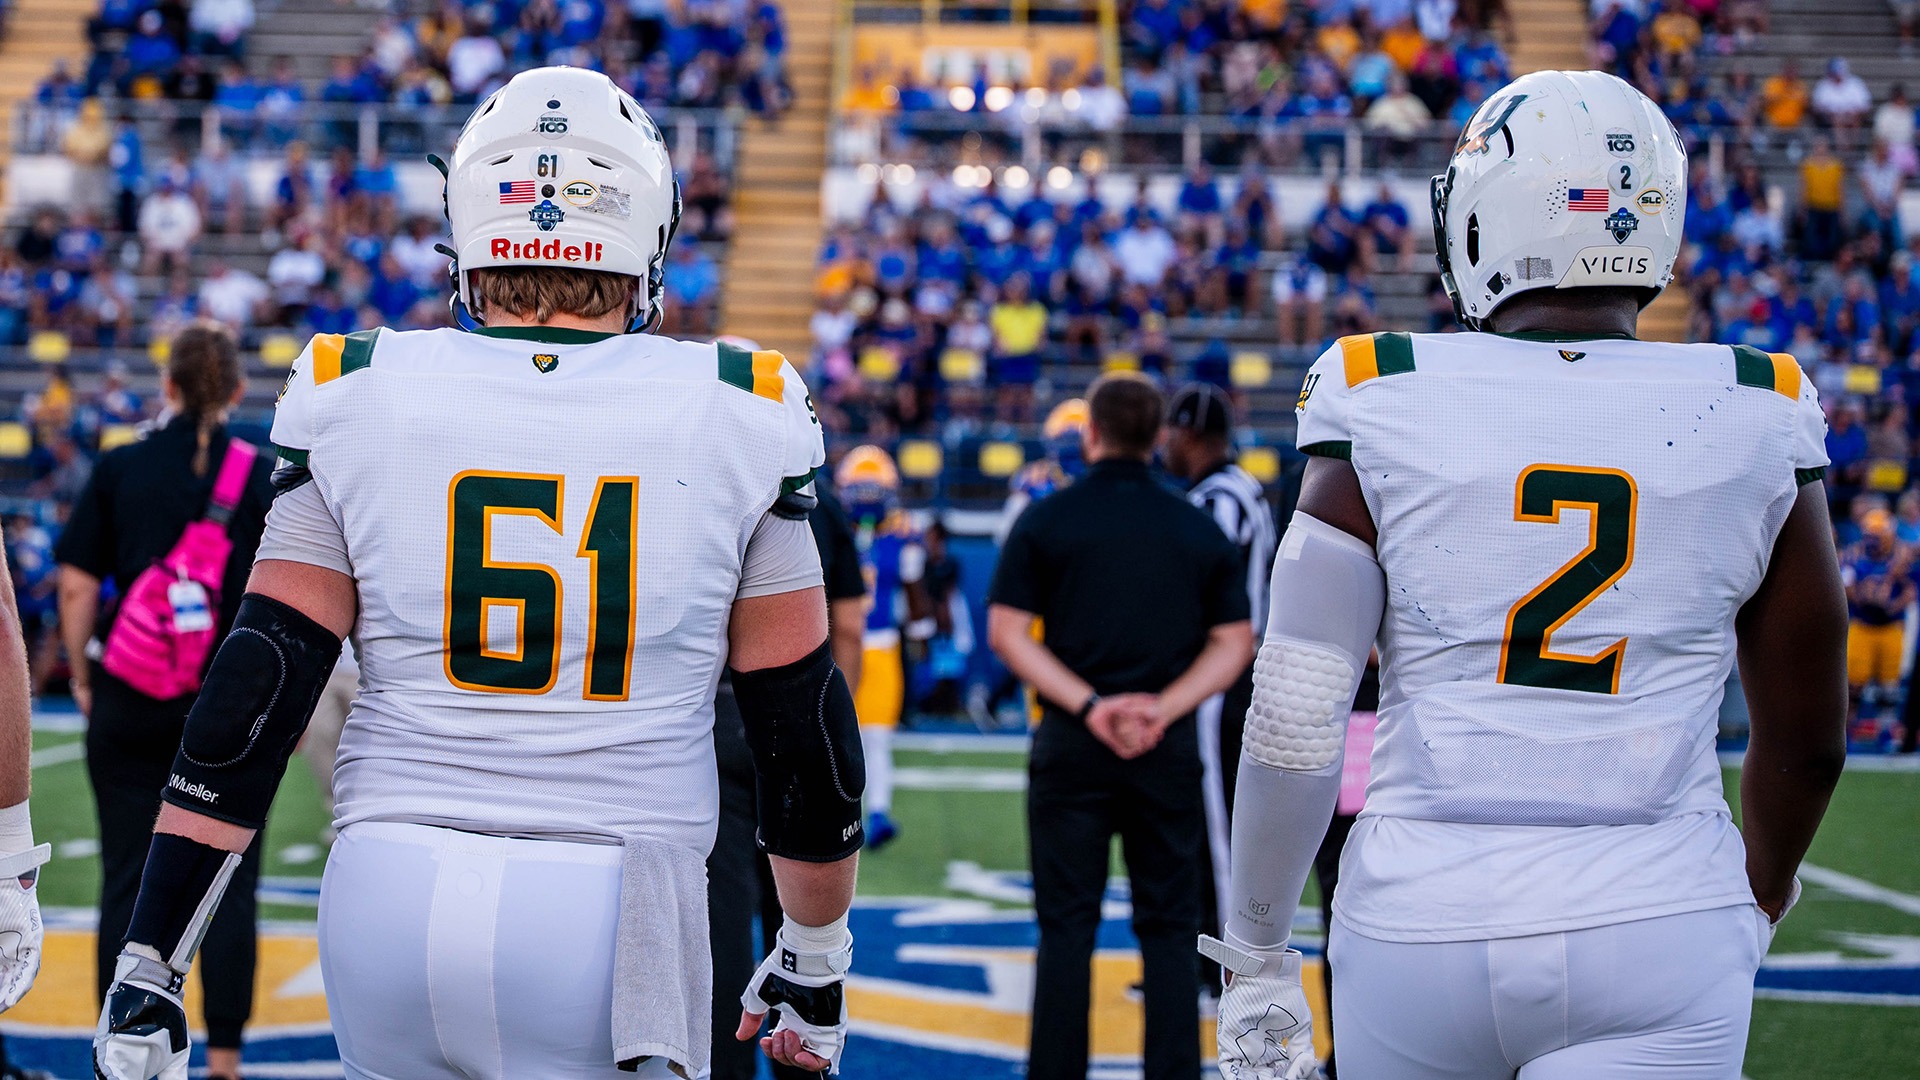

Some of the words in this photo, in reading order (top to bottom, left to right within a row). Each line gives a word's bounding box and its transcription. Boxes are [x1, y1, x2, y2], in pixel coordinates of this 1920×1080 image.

[539, 122, 568, 133] 100
[1607, 140, 1635, 152] 100
[537, 154, 558, 178] 61
[1620, 165, 1632, 190] 2
[567, 187, 592, 195] SLC
[1641, 196, 1662, 204] SLC
[533, 210, 560, 220] FCS
[1609, 220, 1635, 228] FCS
[490, 237, 603, 262] Riddell
[1581, 256, 1649, 275] VICIS
[443, 468, 640, 702] 61
[1496, 462, 1639, 695] 2
[172, 774, 219, 803] Mueller
